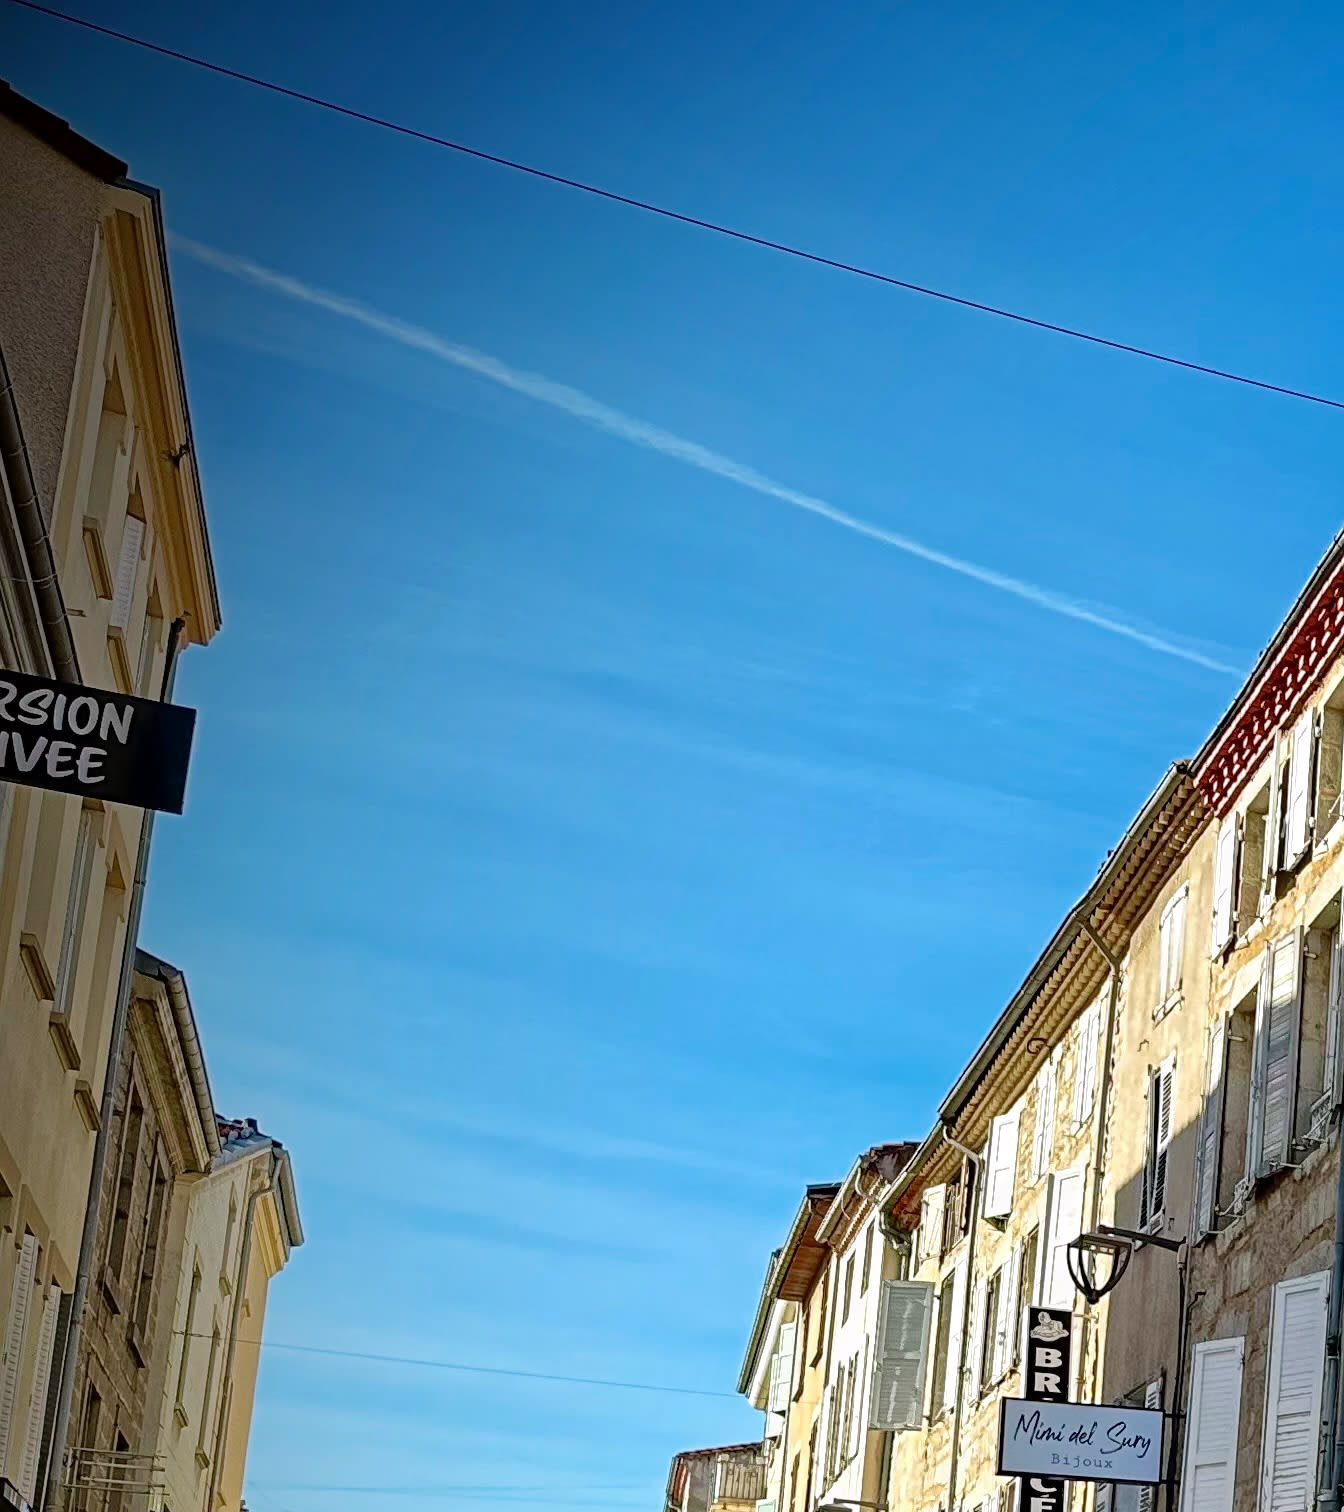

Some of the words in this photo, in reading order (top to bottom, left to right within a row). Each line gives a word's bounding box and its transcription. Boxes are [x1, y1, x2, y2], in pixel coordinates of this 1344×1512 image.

[1068, 1421, 1098, 1446] del
[1100, 1421, 1152, 1459] Sury
[1051, 1453, 1113, 1469] Bijoux
